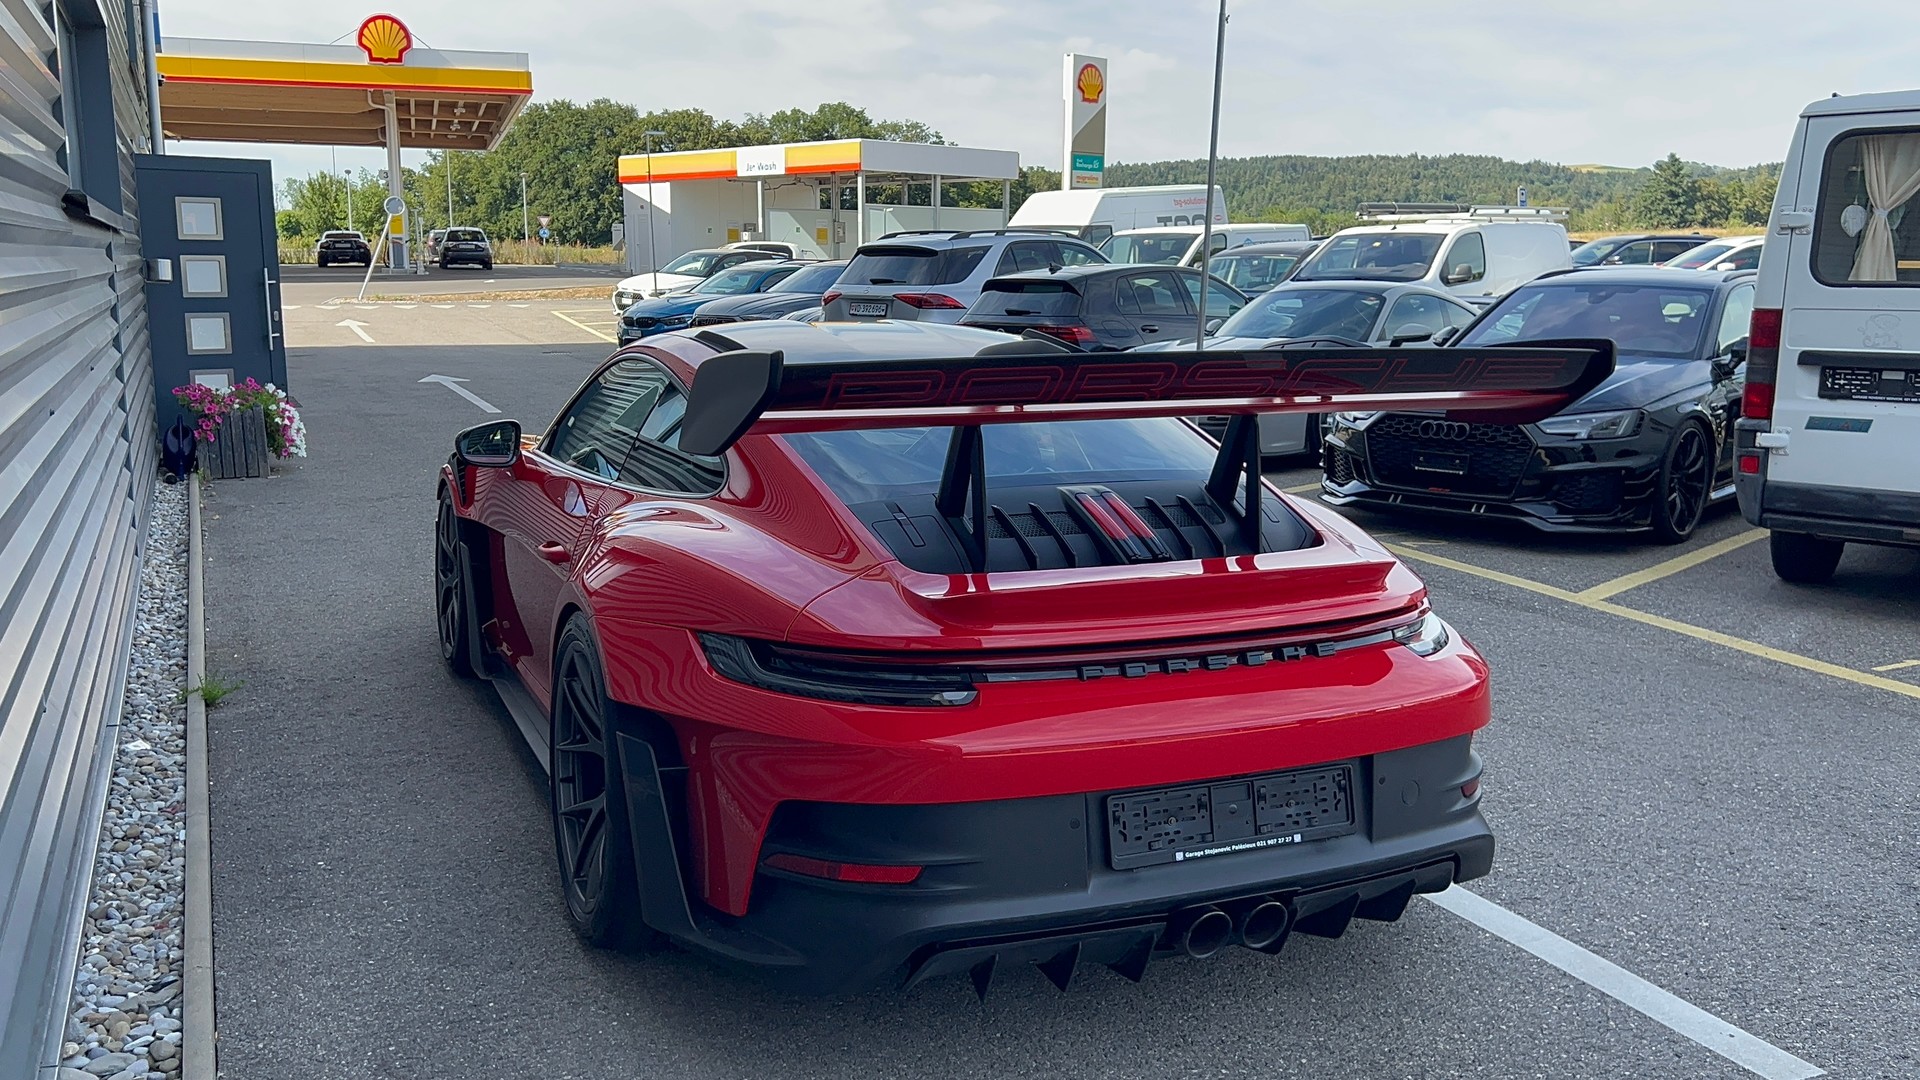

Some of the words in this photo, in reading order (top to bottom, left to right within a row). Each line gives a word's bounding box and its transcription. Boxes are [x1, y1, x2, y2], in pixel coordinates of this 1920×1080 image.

[822, 357, 1567, 408] PORSCHE
[1079, 641, 1336, 681] PORSCHE
[1185, 850, 1204, 858] Garage
[1205, 846, 1231, 854] Stojanovic
